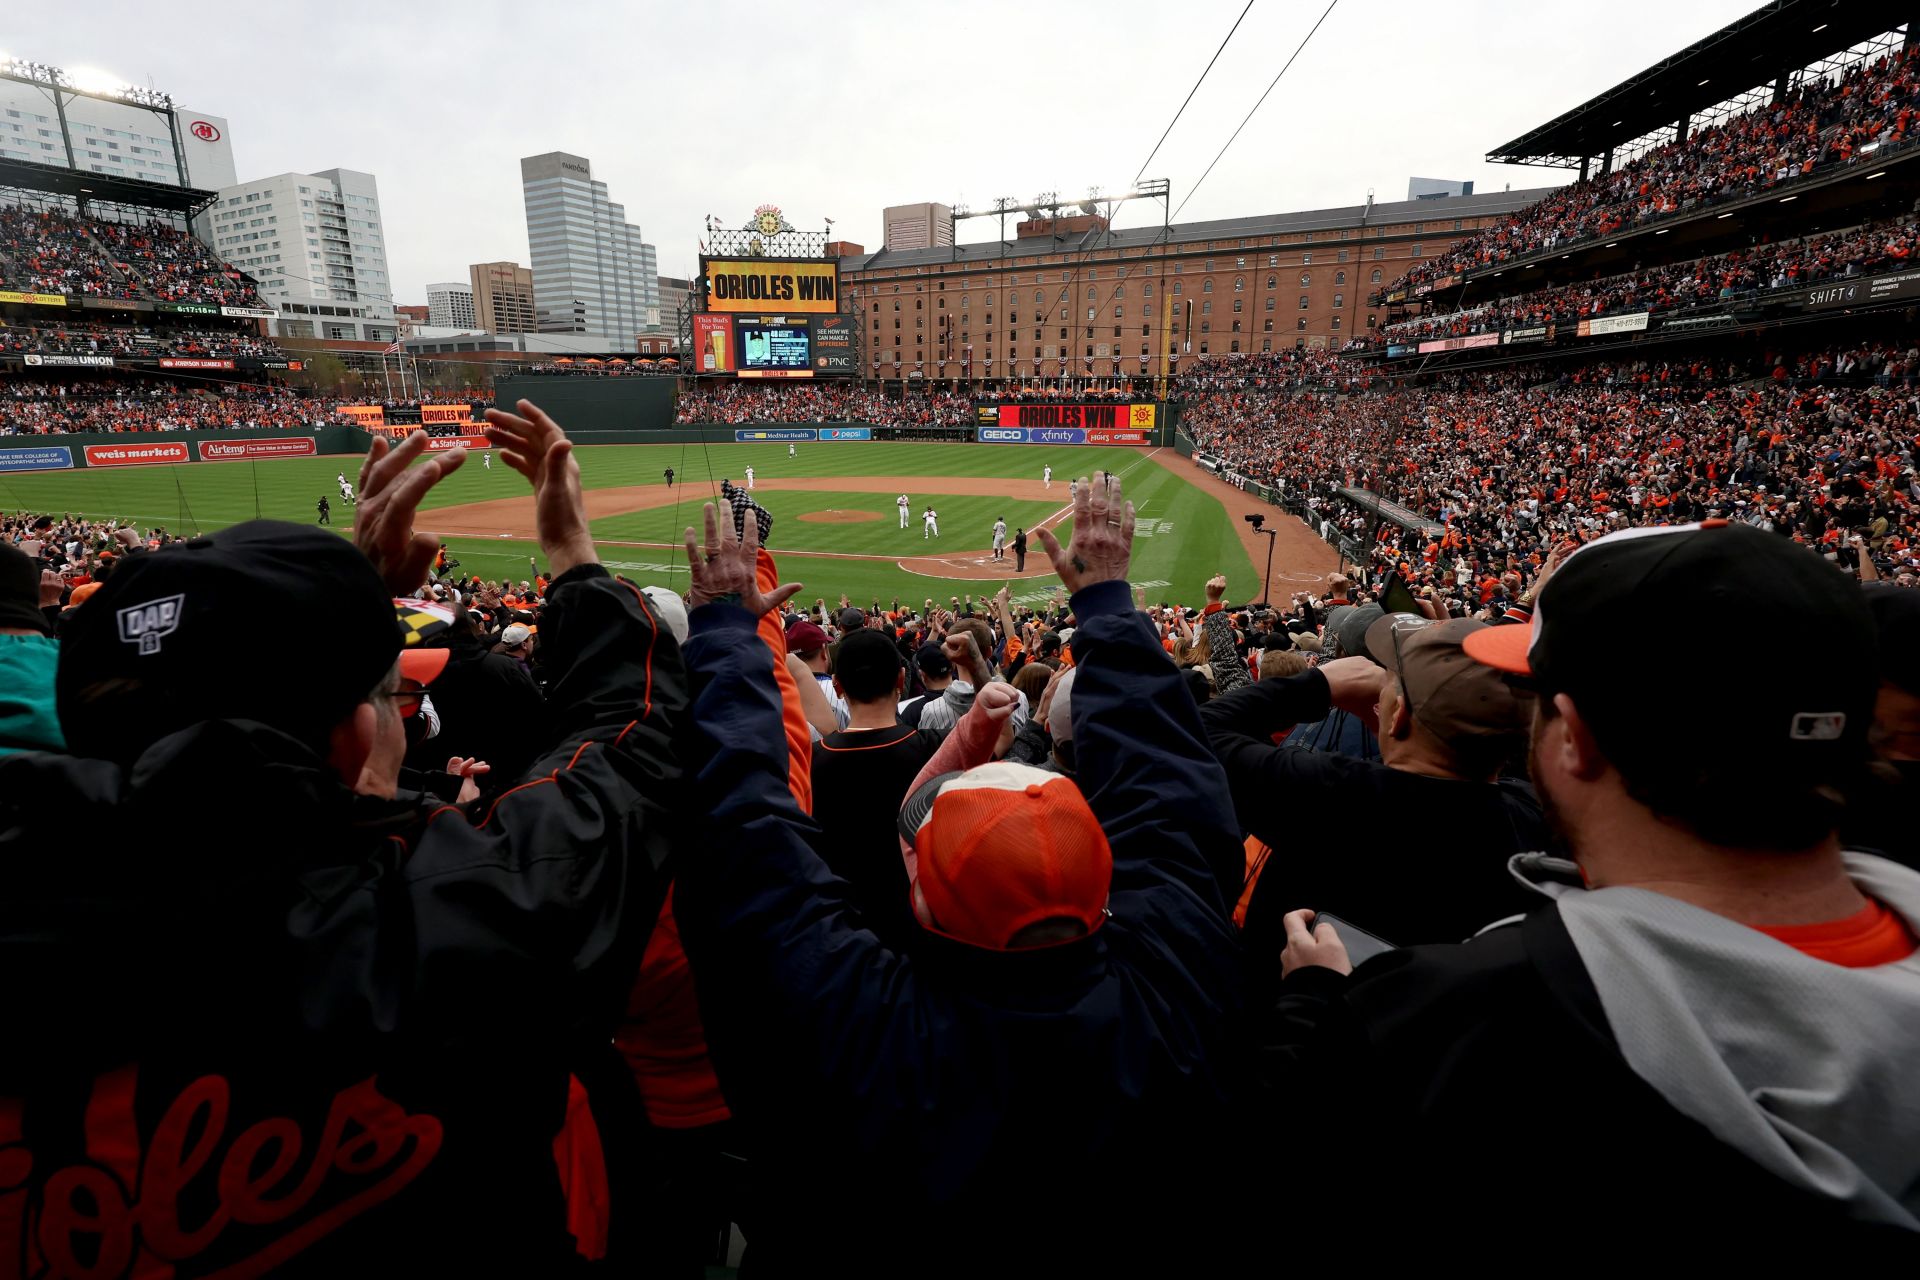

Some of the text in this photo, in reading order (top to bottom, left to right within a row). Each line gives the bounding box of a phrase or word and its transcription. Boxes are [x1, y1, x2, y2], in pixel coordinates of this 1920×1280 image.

[714, 274, 834, 300] ORIOLES WIN
[1809, 288, 1846, 304] SHIFT
[80, 356, 113, 366] UNION
[423, 410, 456, 422] ORIOLES
[1018, 406, 1116, 428] ORIOLES WIN
[984, 430, 1022, 439] GEICO
[1041, 430, 1074, 442] xfinity
[94, 447, 181, 459] weis markets
[208, 445, 244, 455] Airtemp
